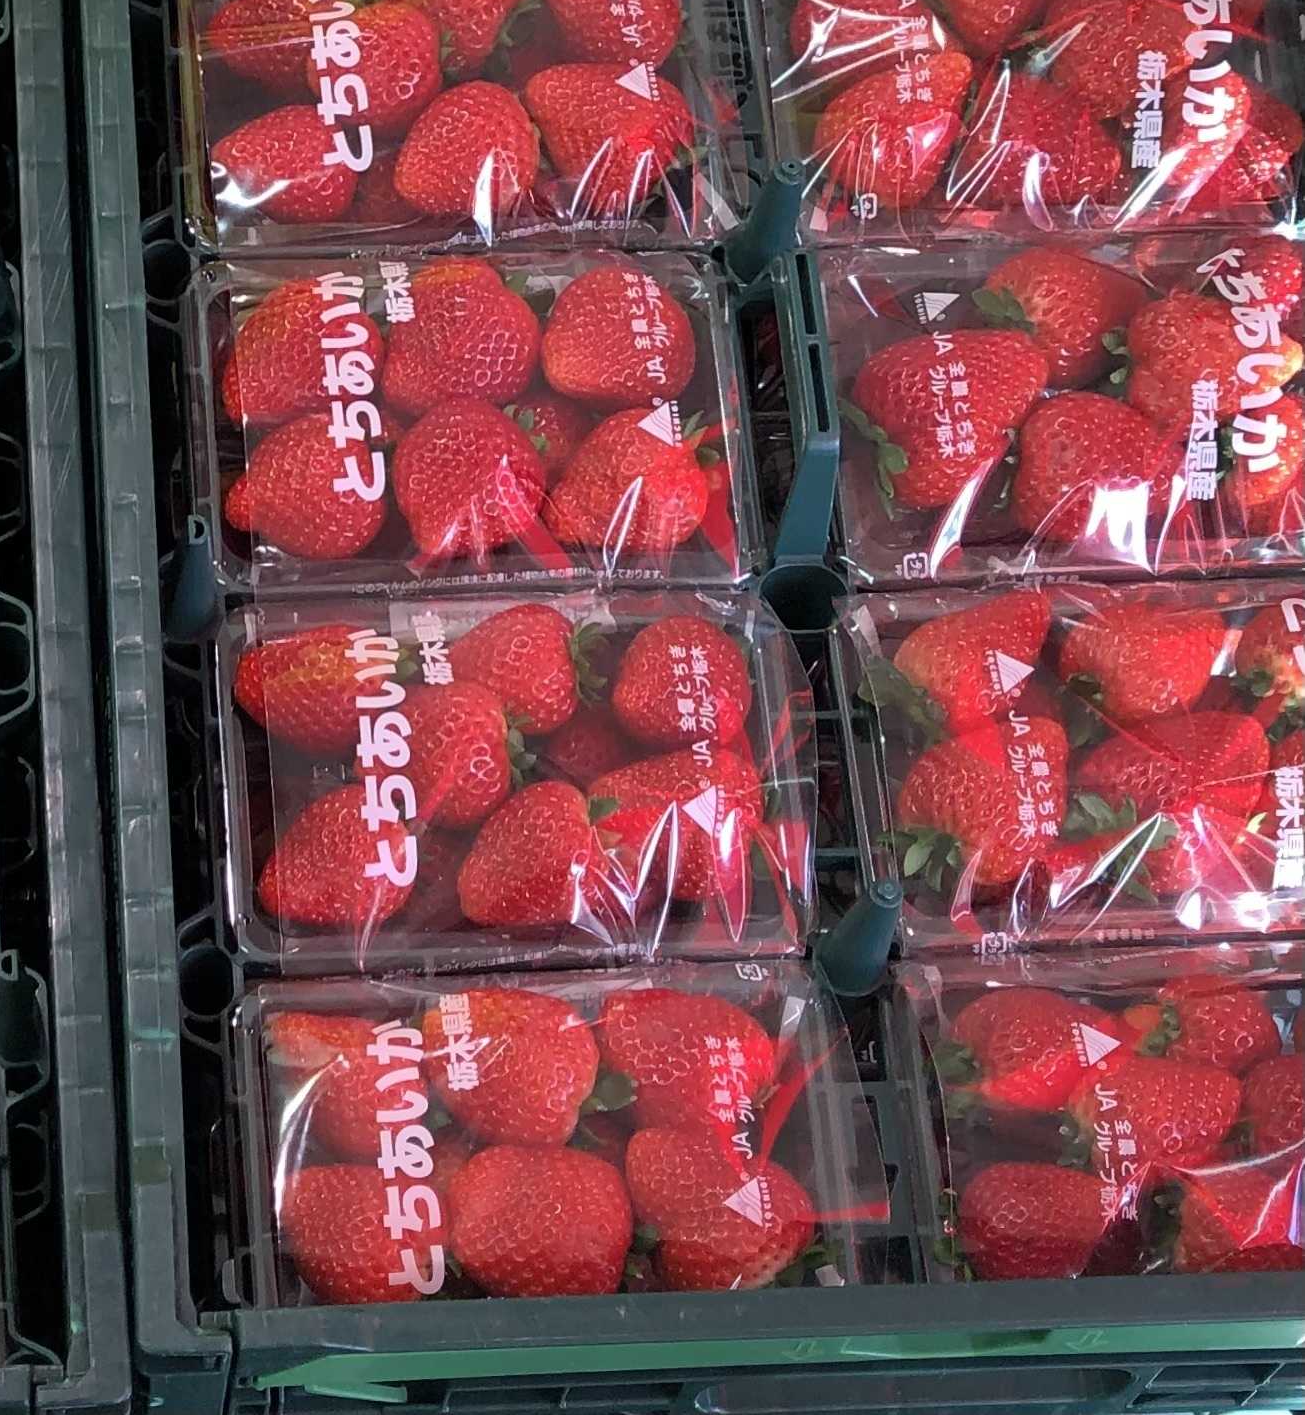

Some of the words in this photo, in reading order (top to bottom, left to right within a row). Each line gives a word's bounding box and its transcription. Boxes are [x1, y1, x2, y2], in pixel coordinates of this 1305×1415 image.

[623, 23, 644, 48] JA
[1131, 49, 1166, 170] 栃木県産
[646, 356, 667, 385] JA
[932, 331, 954, 357] JA
[1195, 247, 1290, 474] とちあいか
[312, 270, 386, 503] とちあいか
[1185, 379, 1219, 501] 栃木県産
[694, 740, 713, 768] JA
[1008, 710, 1032, 738] JA
[344, 629, 418, 888] とちあいか
[437, 992, 481, 1092] 栃木県産
[1094, 1084, 1118, 1113] JA
[366, 1018, 447, 1297] とちあいか
[731, 1130, 753, 1161] JA
